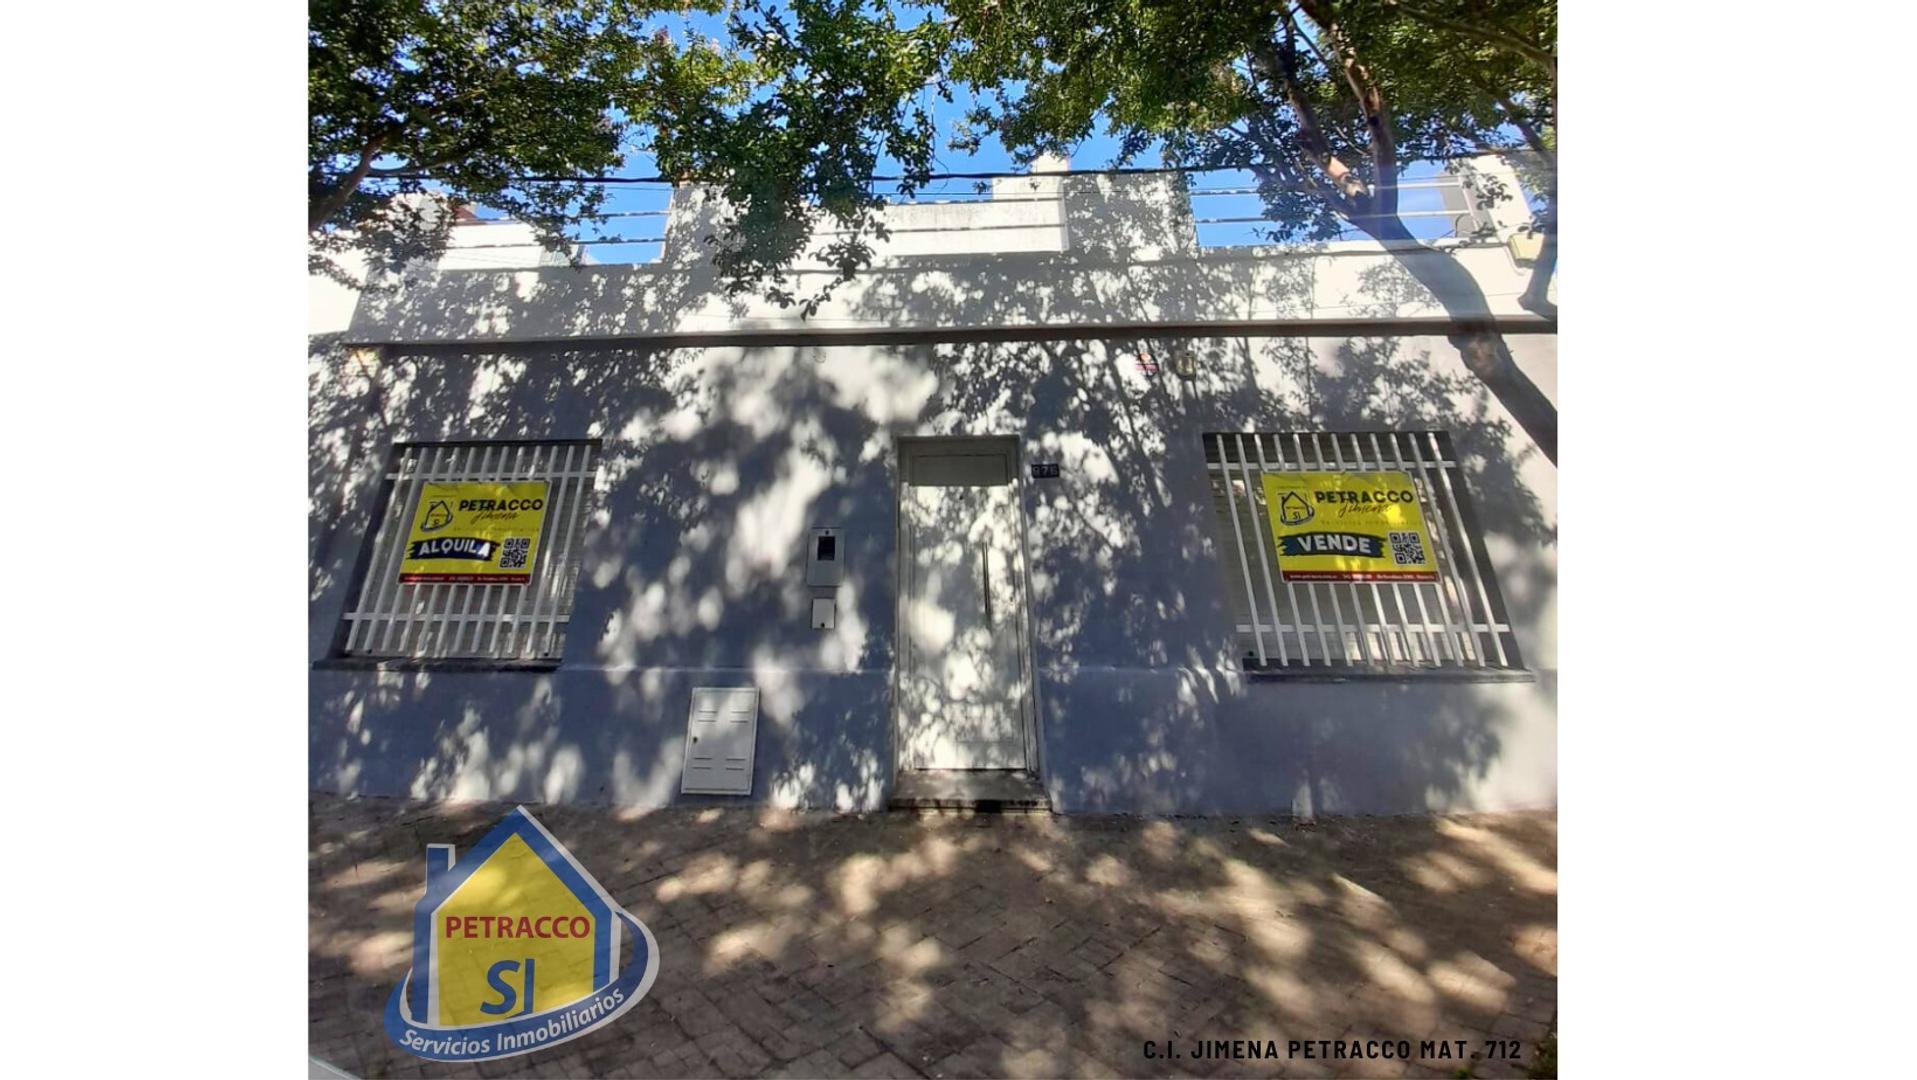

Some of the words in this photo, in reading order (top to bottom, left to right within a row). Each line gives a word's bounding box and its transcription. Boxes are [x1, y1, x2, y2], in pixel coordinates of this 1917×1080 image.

[1314, 490, 1413, 503] PETRACCO
[458, 499, 544, 511] PETRACCO
[418, 538, 491, 557] ALQUILA
[1297, 533, 1372, 554] VENDE
